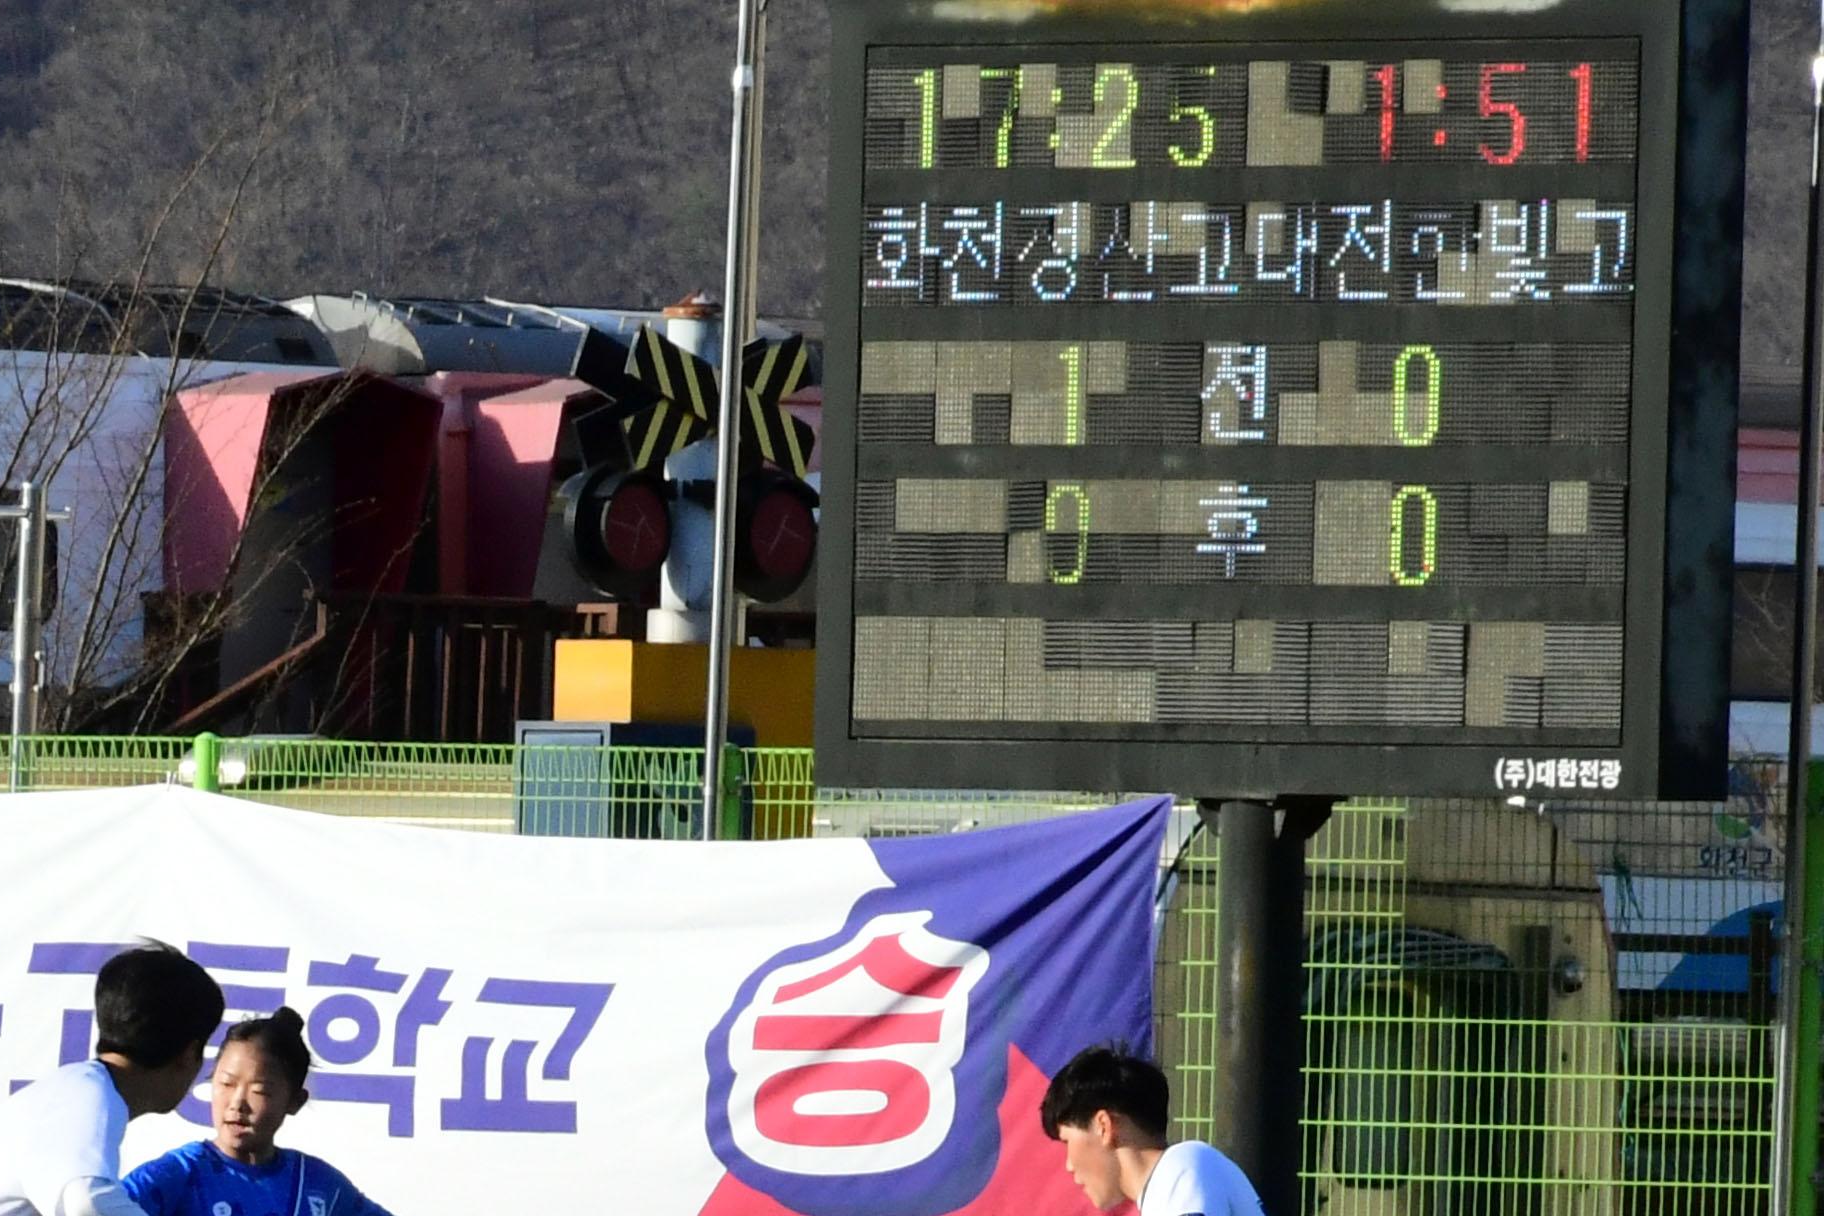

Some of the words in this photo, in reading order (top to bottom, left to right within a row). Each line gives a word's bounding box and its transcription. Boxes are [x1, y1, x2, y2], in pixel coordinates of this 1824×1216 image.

[914, 67, 1215, 168] 17:25
[1373, 63, 1593, 165] 1:51
[1059, 345, 1079, 445] 1
[1200, 345, 1267, 439] 전
[1393, 344, 1441, 447] 0
[1195, 484, 1268, 580] 후
[1389, 484, 1437, 586] 0
[1494, 757, 1622, 790] (주)대한전광
